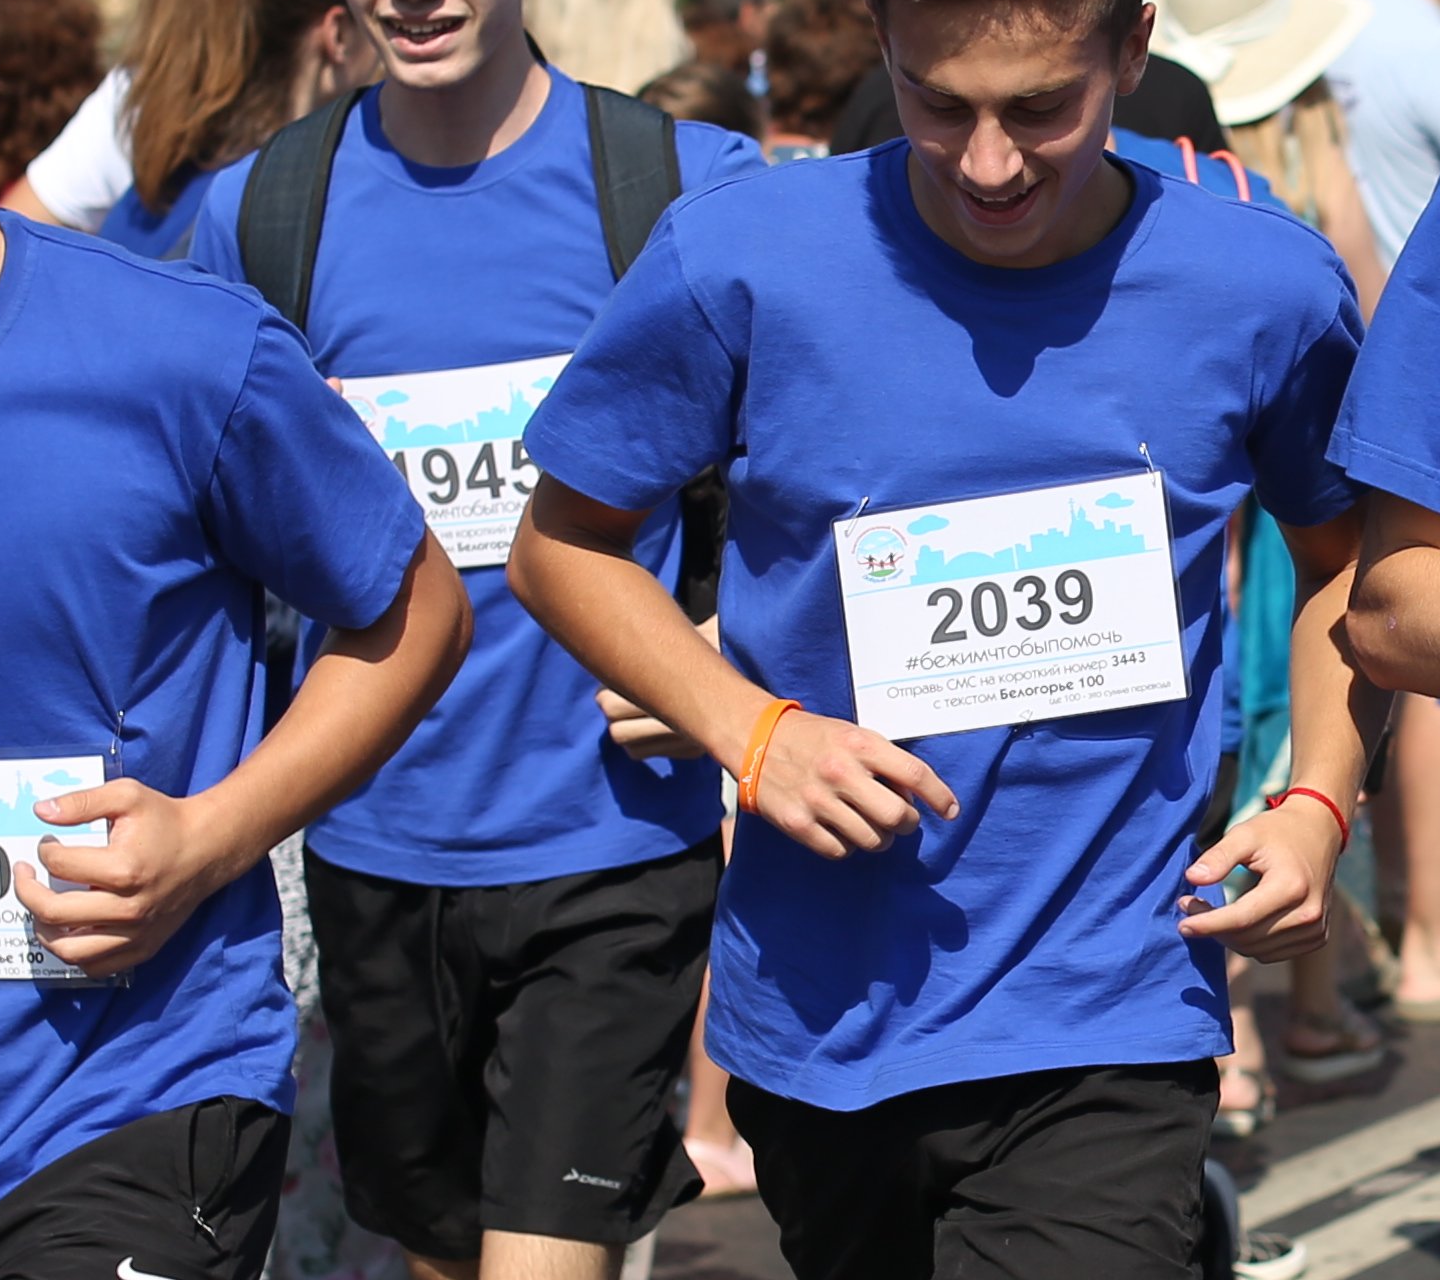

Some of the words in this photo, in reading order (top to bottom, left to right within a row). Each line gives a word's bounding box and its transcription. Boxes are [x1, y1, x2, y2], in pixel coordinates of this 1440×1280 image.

[926, 569, 1094, 645] 2039
[906, 632, 1121, 669] #бежимчтобыпомочь
[886, 683, 943, 698] Отправь
[945, 675, 976, 690] СМС
[979, 675, 995, 686] на
[998, 664, 1060, 683] короткий
[1063, 659, 1107, 673] номер
[1111, 651, 1145, 666] 3443
[944, 693, 997, 707] текстом
[999, 681, 1073, 699] Белогорье
[1078, 674, 1104, 687] 100
[1064, 692, 1081, 702] 100
[4, 934, 41, 951] номе
[19, 952, 44, 964] 100
